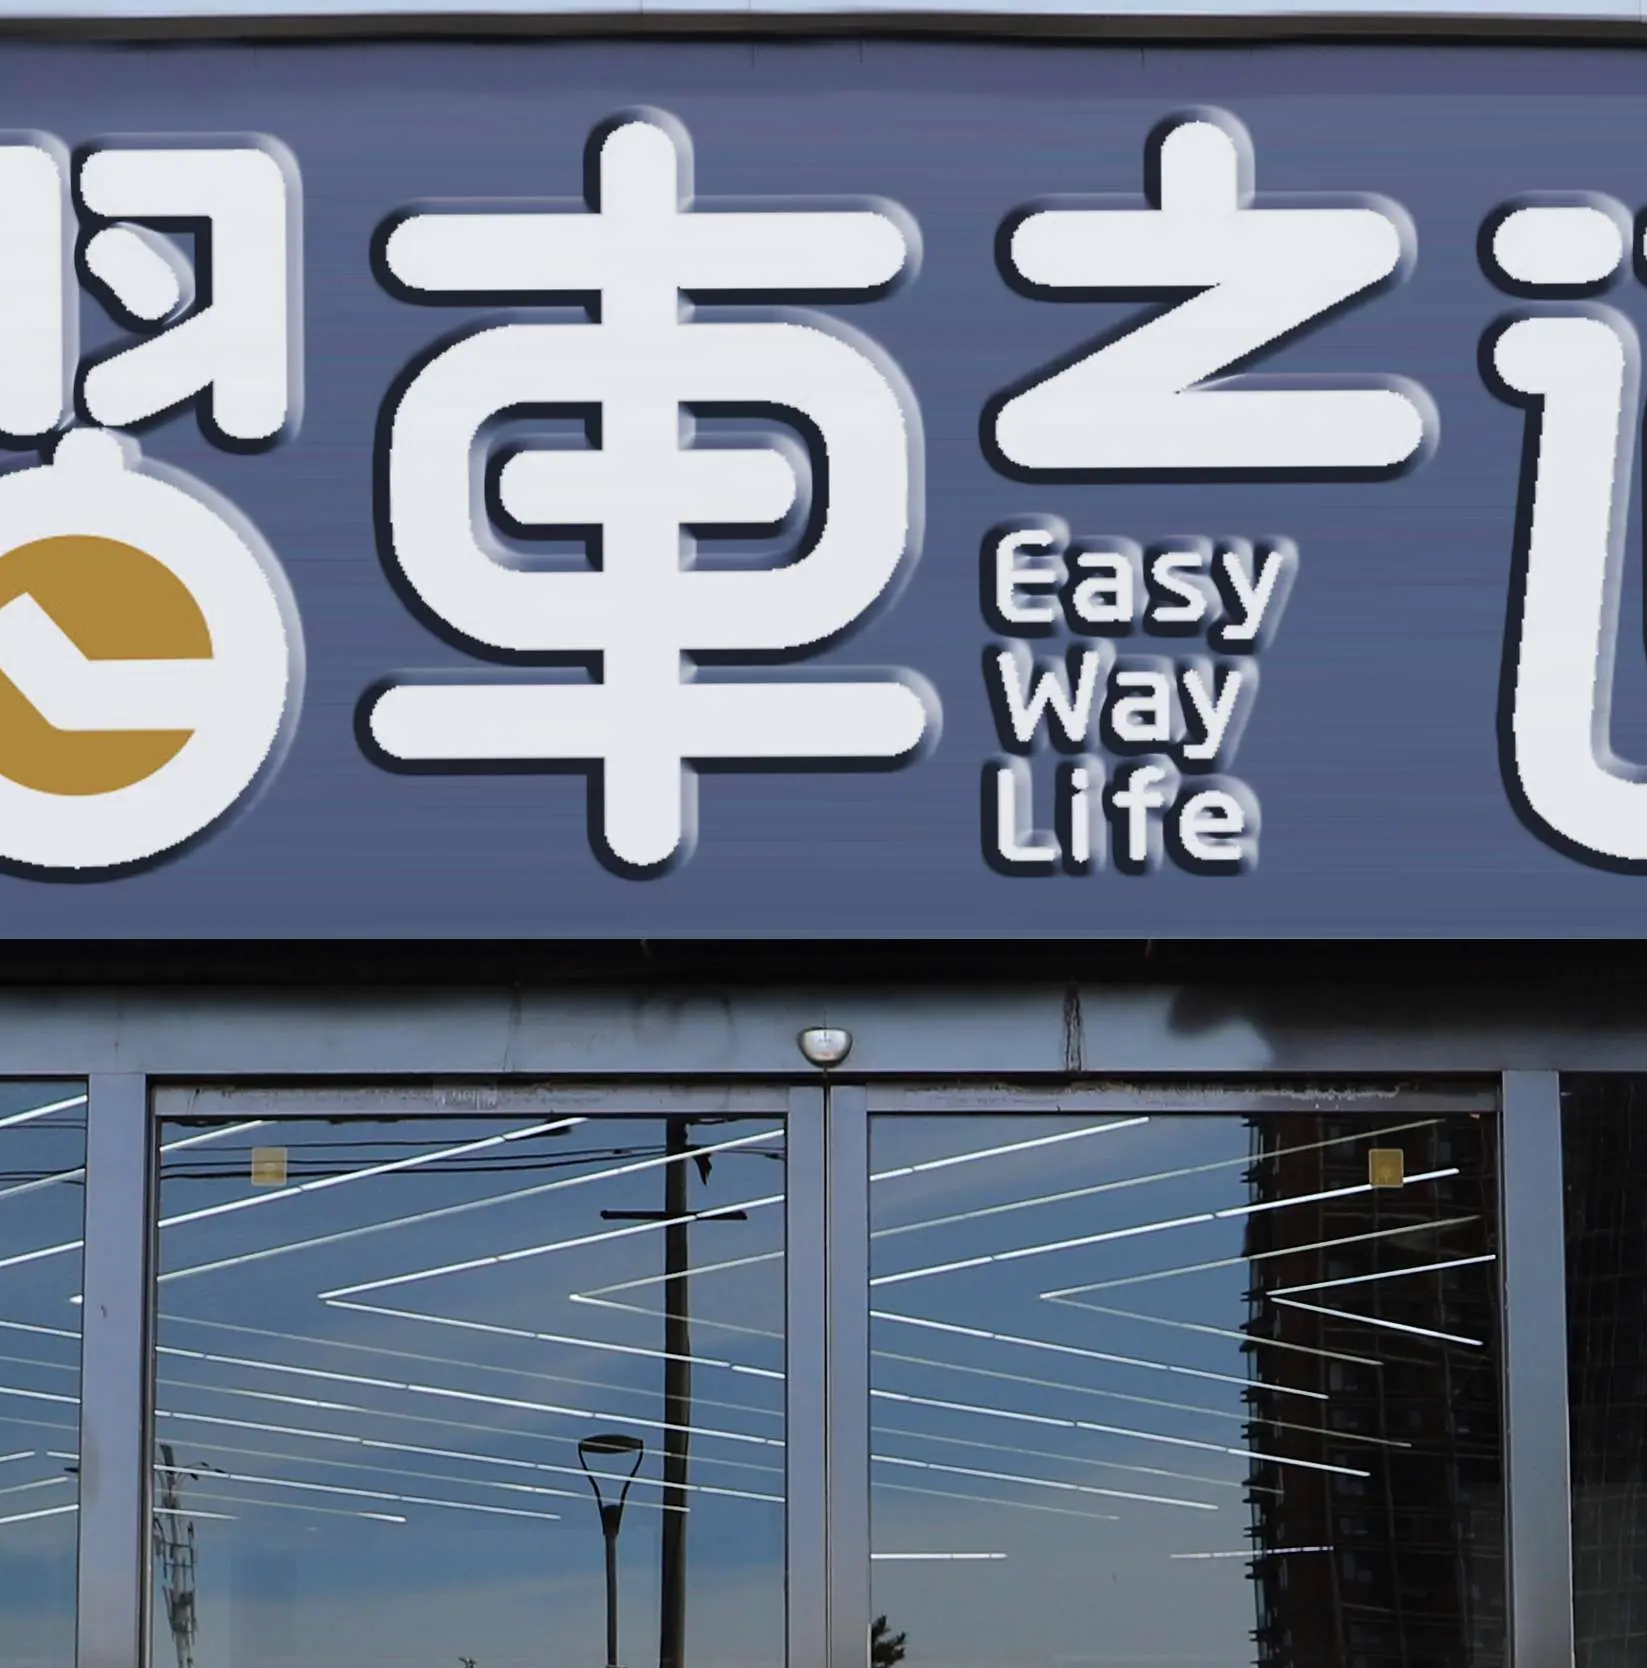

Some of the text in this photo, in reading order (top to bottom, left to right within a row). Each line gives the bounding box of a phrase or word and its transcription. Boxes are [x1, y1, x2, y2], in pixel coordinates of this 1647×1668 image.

[995, 529, 1284, 640] Easy
[995, 651, 1244, 760] Way
[996, 765, 1245, 864] Life
